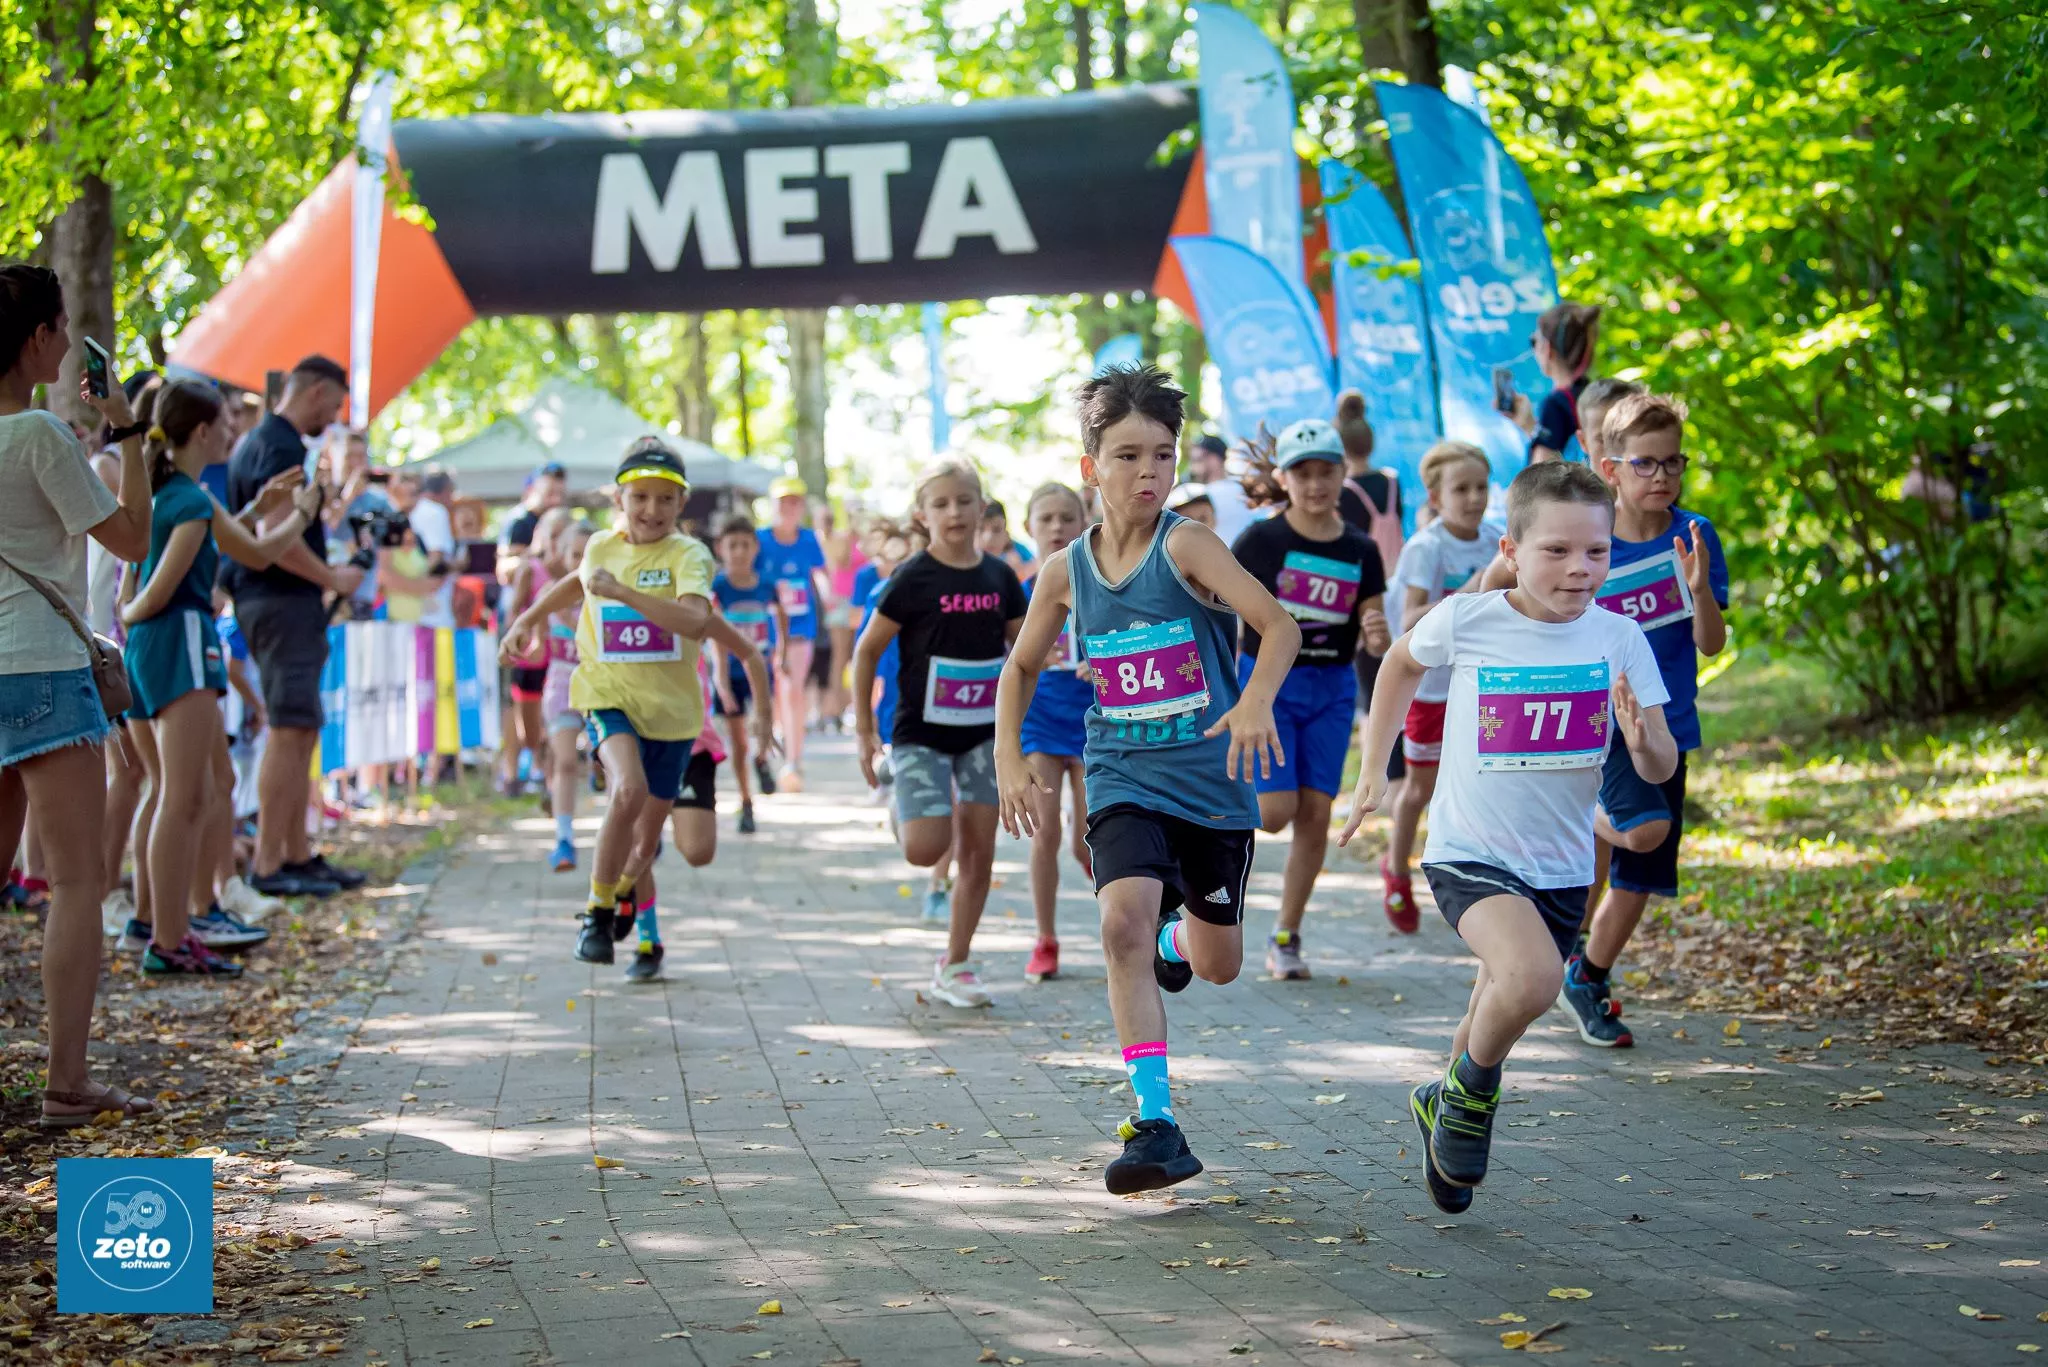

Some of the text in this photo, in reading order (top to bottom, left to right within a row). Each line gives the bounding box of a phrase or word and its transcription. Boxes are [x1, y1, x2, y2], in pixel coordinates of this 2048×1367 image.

[592, 137, 1038, 273] META
[1308, 577, 1339, 605] 70
[1621, 591, 1657, 618] 50
[619, 625, 650, 647] 49
[1118, 657, 1165, 695] 84
[954, 684, 985, 704] 47
[1524, 701, 1572, 740] 77
[1205, 895, 1230, 904] adidas
